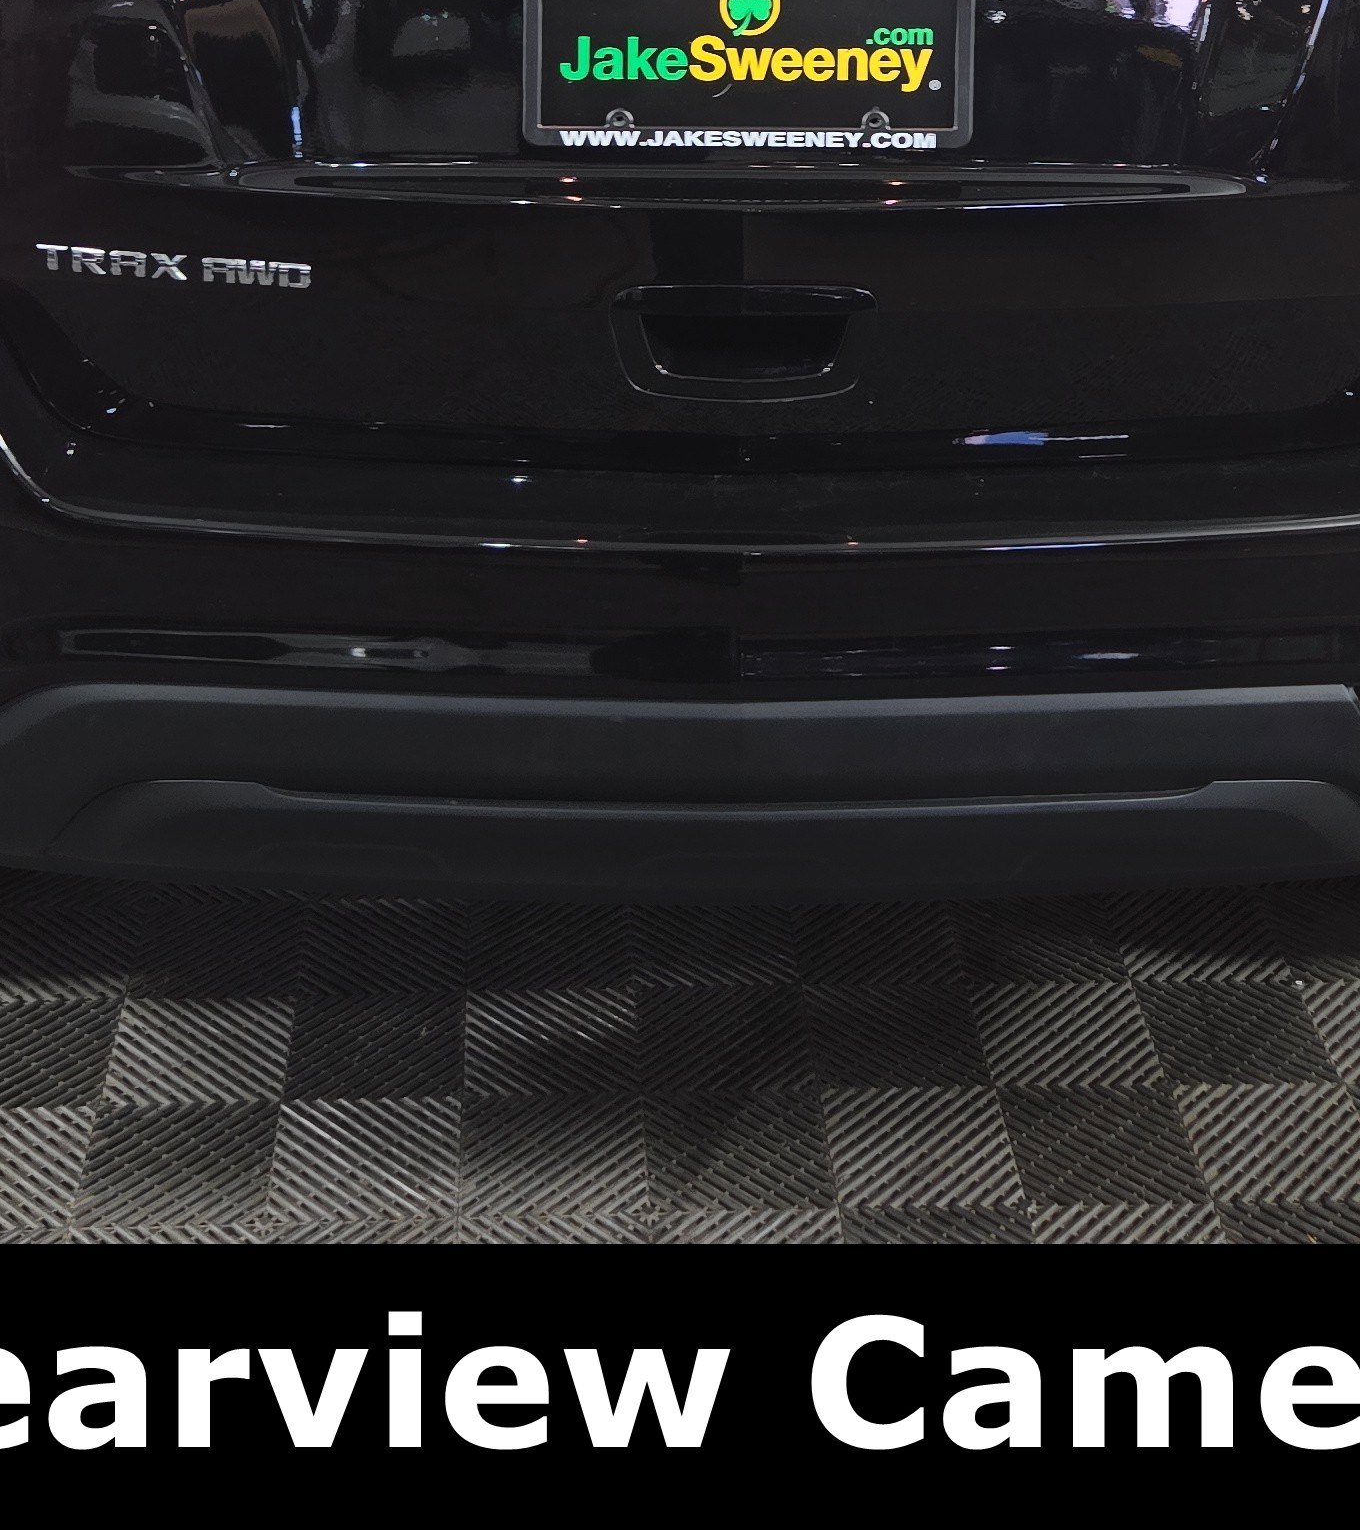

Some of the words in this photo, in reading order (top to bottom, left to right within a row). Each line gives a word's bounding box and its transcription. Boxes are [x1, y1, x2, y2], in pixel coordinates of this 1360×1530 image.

[560, 130, 936, 150] WWW.JAKESWEENEY.COM
[36, 243, 187, 281] TRAX
[201, 256, 312, 289] AWD
